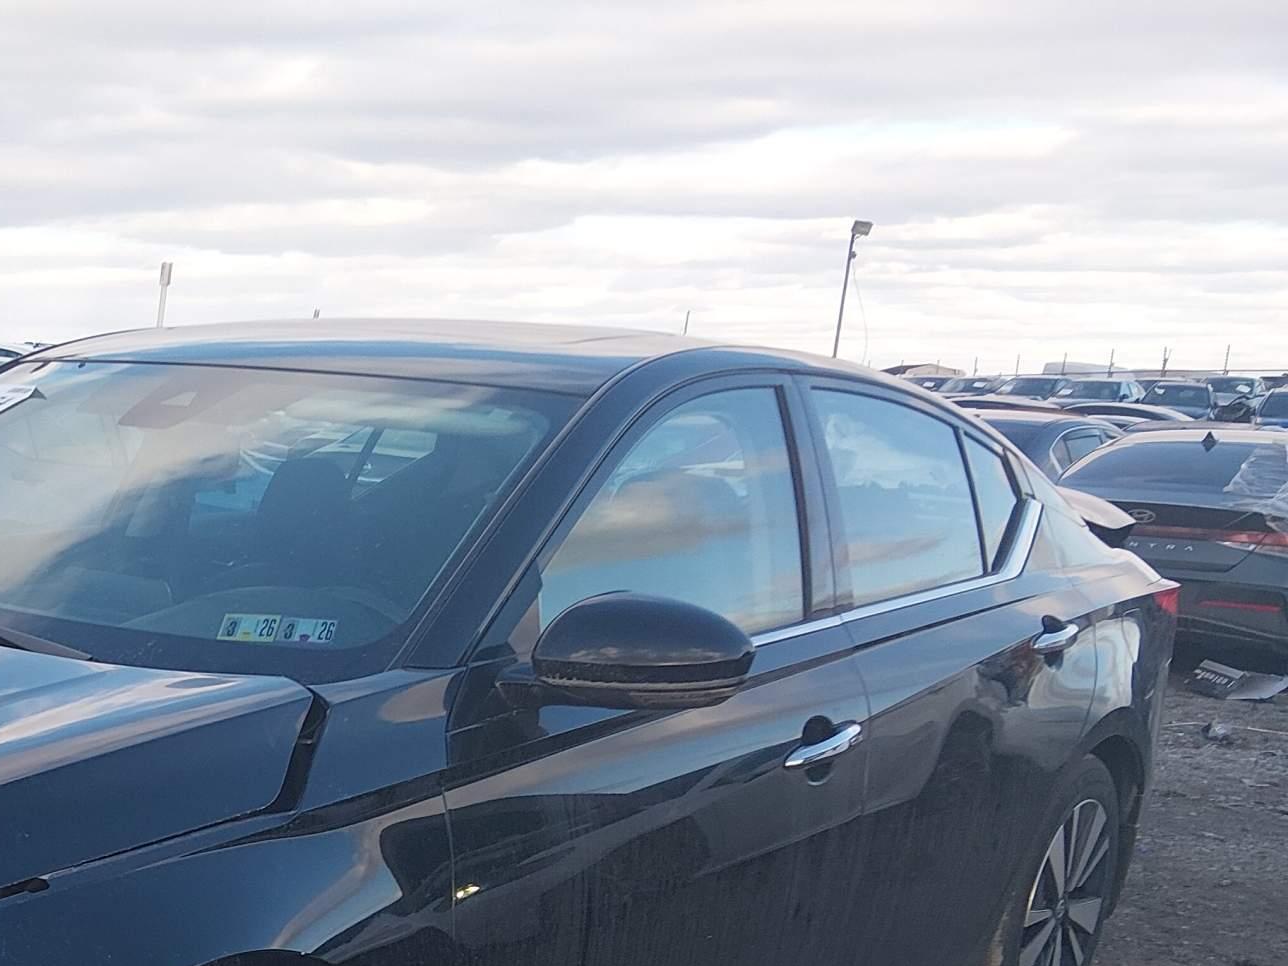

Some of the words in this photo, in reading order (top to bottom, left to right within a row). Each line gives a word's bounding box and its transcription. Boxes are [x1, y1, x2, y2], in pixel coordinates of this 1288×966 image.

[1128, 541, 1194, 552] NTRA
[259, 618, 277, 637] 26
[317, 621, 335, 641] 26
